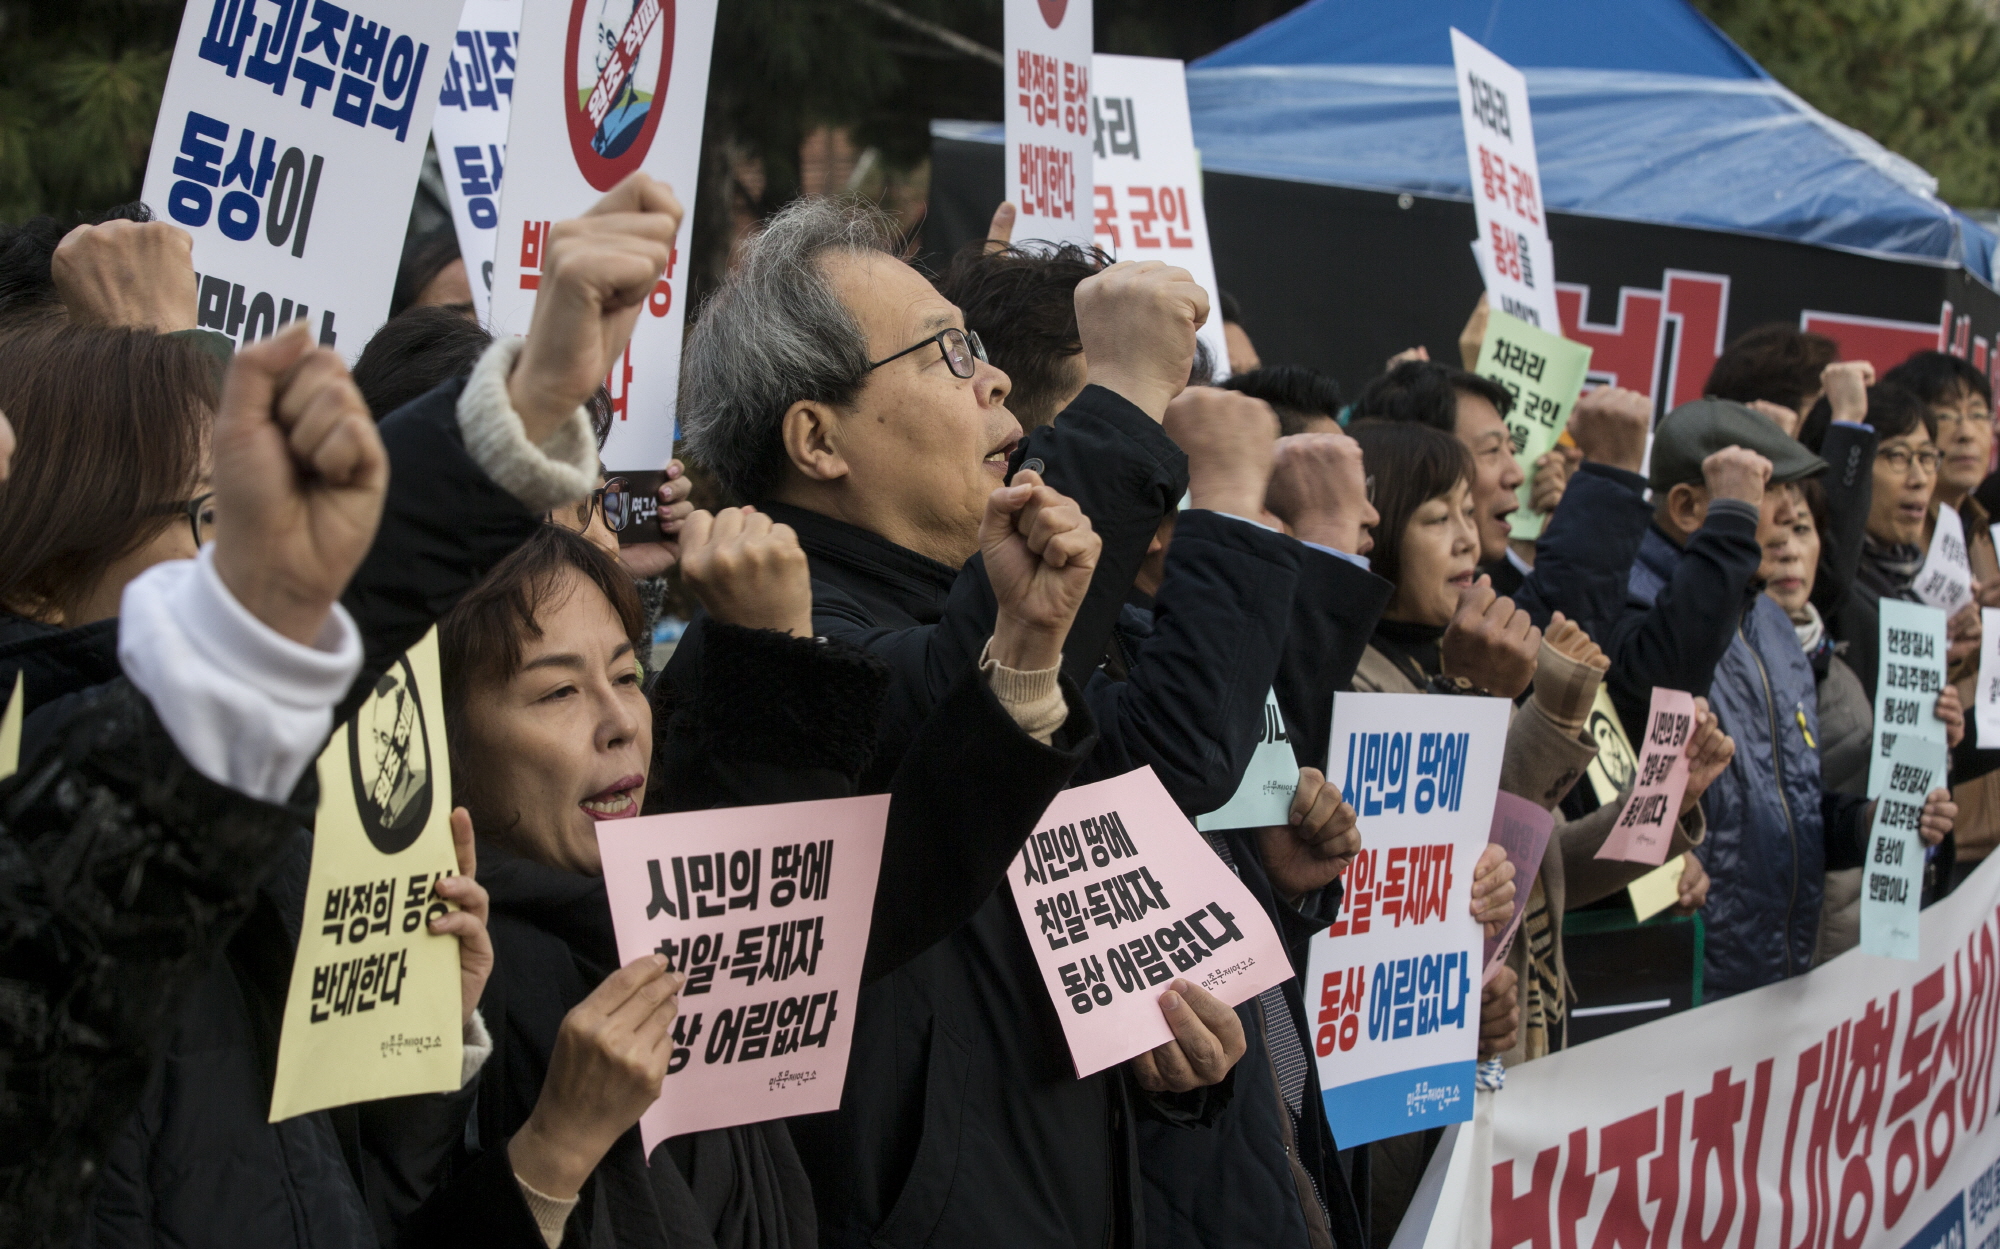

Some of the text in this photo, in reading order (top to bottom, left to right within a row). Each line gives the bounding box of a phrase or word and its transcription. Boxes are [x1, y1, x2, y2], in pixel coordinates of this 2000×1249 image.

[199, 0, 429, 142] 파괴주범의
[588, 51, 624, 130] 원조
[1018, 49, 1060, 128] 박정희
[1064, 61, 1088, 136] 동상
[168, 111, 324, 258] 동상이
[1019, 143, 1075, 220] 반대한다
[1127, 187, 1194, 249] 군인
[1492, 337, 1546, 383] 차라리
[1525, 392, 1561, 428] 군인
[1884, 698, 1920, 727] 동상이
[1341, 732, 1469, 816] 시민의 땅에
[646, 839, 834, 921] 시민의 땅에
[1022, 811, 1138, 886] 시민의 땅에
[1874, 837, 1904, 867] 동상이
[322, 877, 397, 946] 박정희
[1869, 872, 1908, 905] 웬말이냐
[310, 949, 407, 1024] 반대한다
[1058, 901, 1244, 1014] 동상 어림없다
[1201, 956, 1256, 991] 민족문제연구소
[665, 989, 838, 1076] 상 어림없다
[1316, 951, 1470, 1058] 동상 어림없다
[381, 1033, 442, 1059] 민족문제연구소
[769, 1069, 817, 1092] 민족문제연구소
[1406, 1081, 1460, 1117] 민족문제연구소
